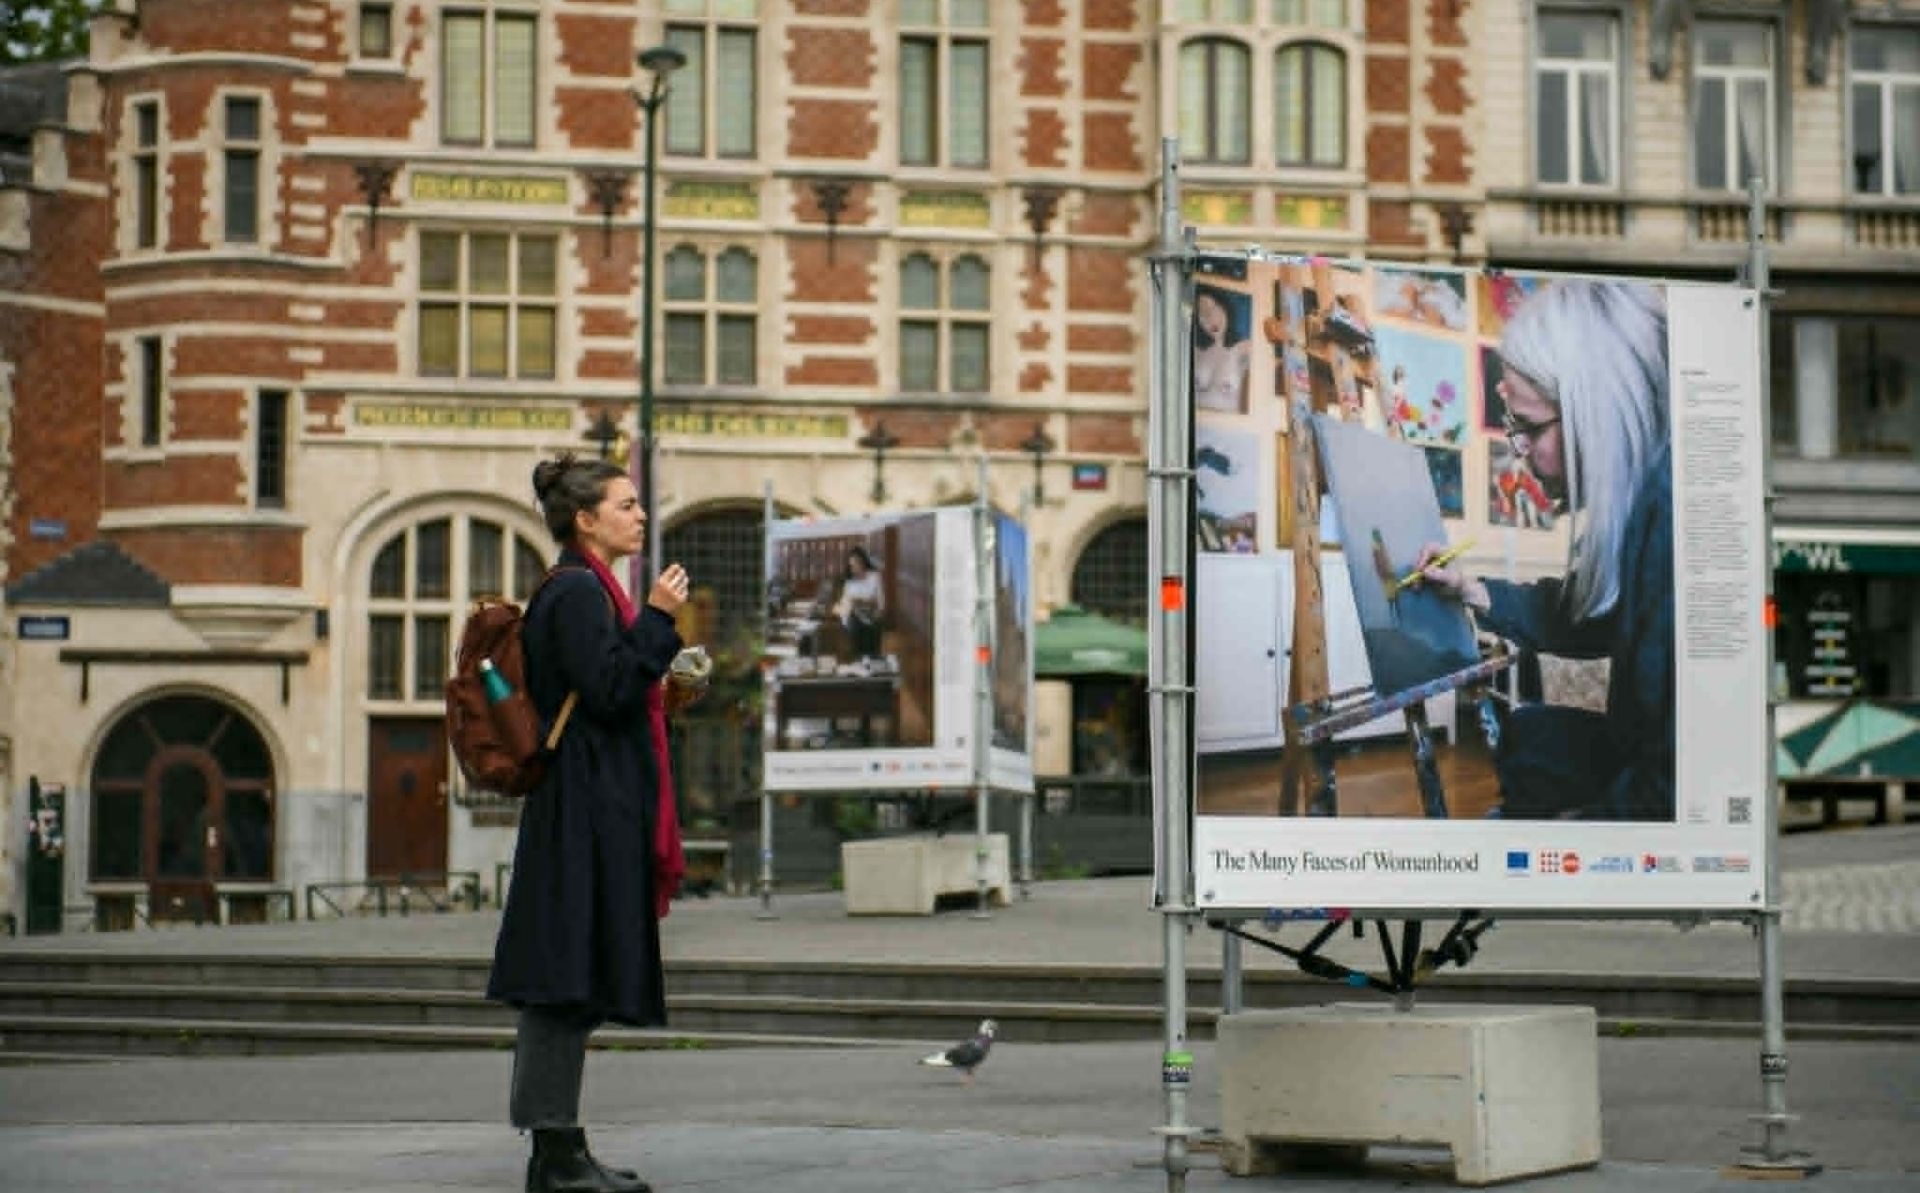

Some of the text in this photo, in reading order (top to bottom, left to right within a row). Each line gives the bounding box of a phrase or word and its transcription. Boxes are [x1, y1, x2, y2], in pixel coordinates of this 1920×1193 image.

[1211, 849, 1479, 878] The Many Faces of Womanhood
